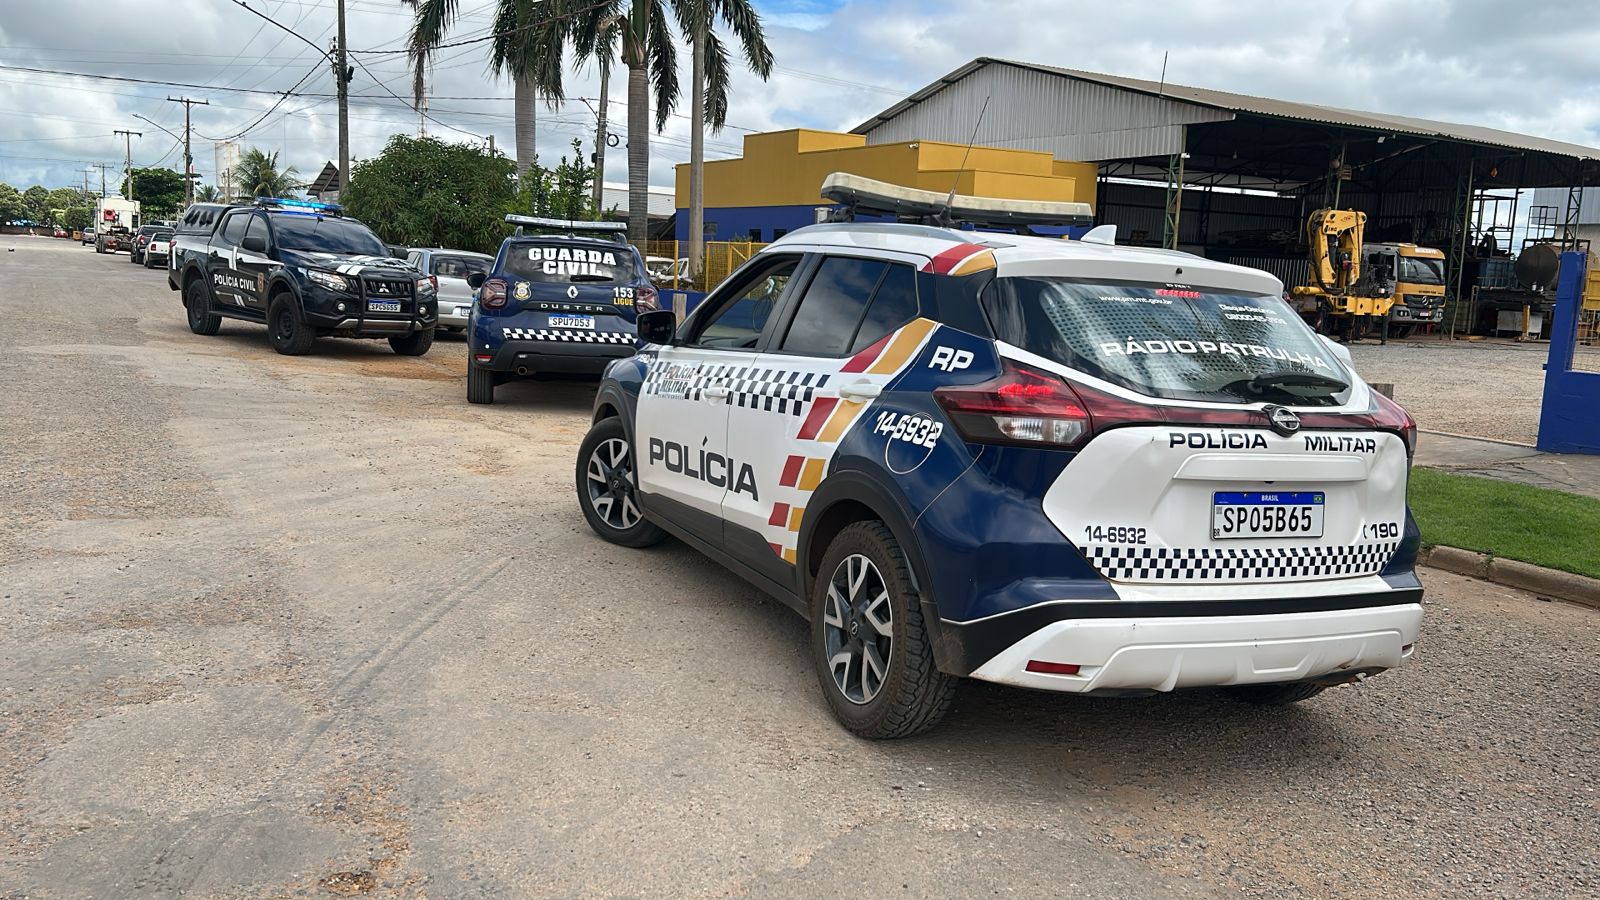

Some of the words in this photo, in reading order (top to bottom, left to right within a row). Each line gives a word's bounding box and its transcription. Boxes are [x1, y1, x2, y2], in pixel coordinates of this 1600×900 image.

[528, 247, 617, 266] GUARDA
[542, 260, 603, 276] CIVIL
[213, 273, 238, 288] POLÍCIA
[239, 278, 256, 292] CIVIL
[613, 286, 634, 298] 153
[540, 303, 604, 312] DUSTER
[613, 298, 634, 306] LIGUE
[928, 345, 975, 372] RP
[1100, 336, 1197, 357] RÁDIO
[1197, 341, 1332, 371] PATRULHA
[660, 379, 688, 394] MILITAR
[873, 410, 944, 449] 14-6932
[1169, 429, 1268, 449] POLÍCIA
[1305, 435, 1376, 454] MILITAR
[649, 436, 759, 502] POLÍCIA
[1261, 494, 1279, 502] BRASIL
[1084, 525, 1147, 545] 14-6932
[1370, 522, 1398, 539] 190
